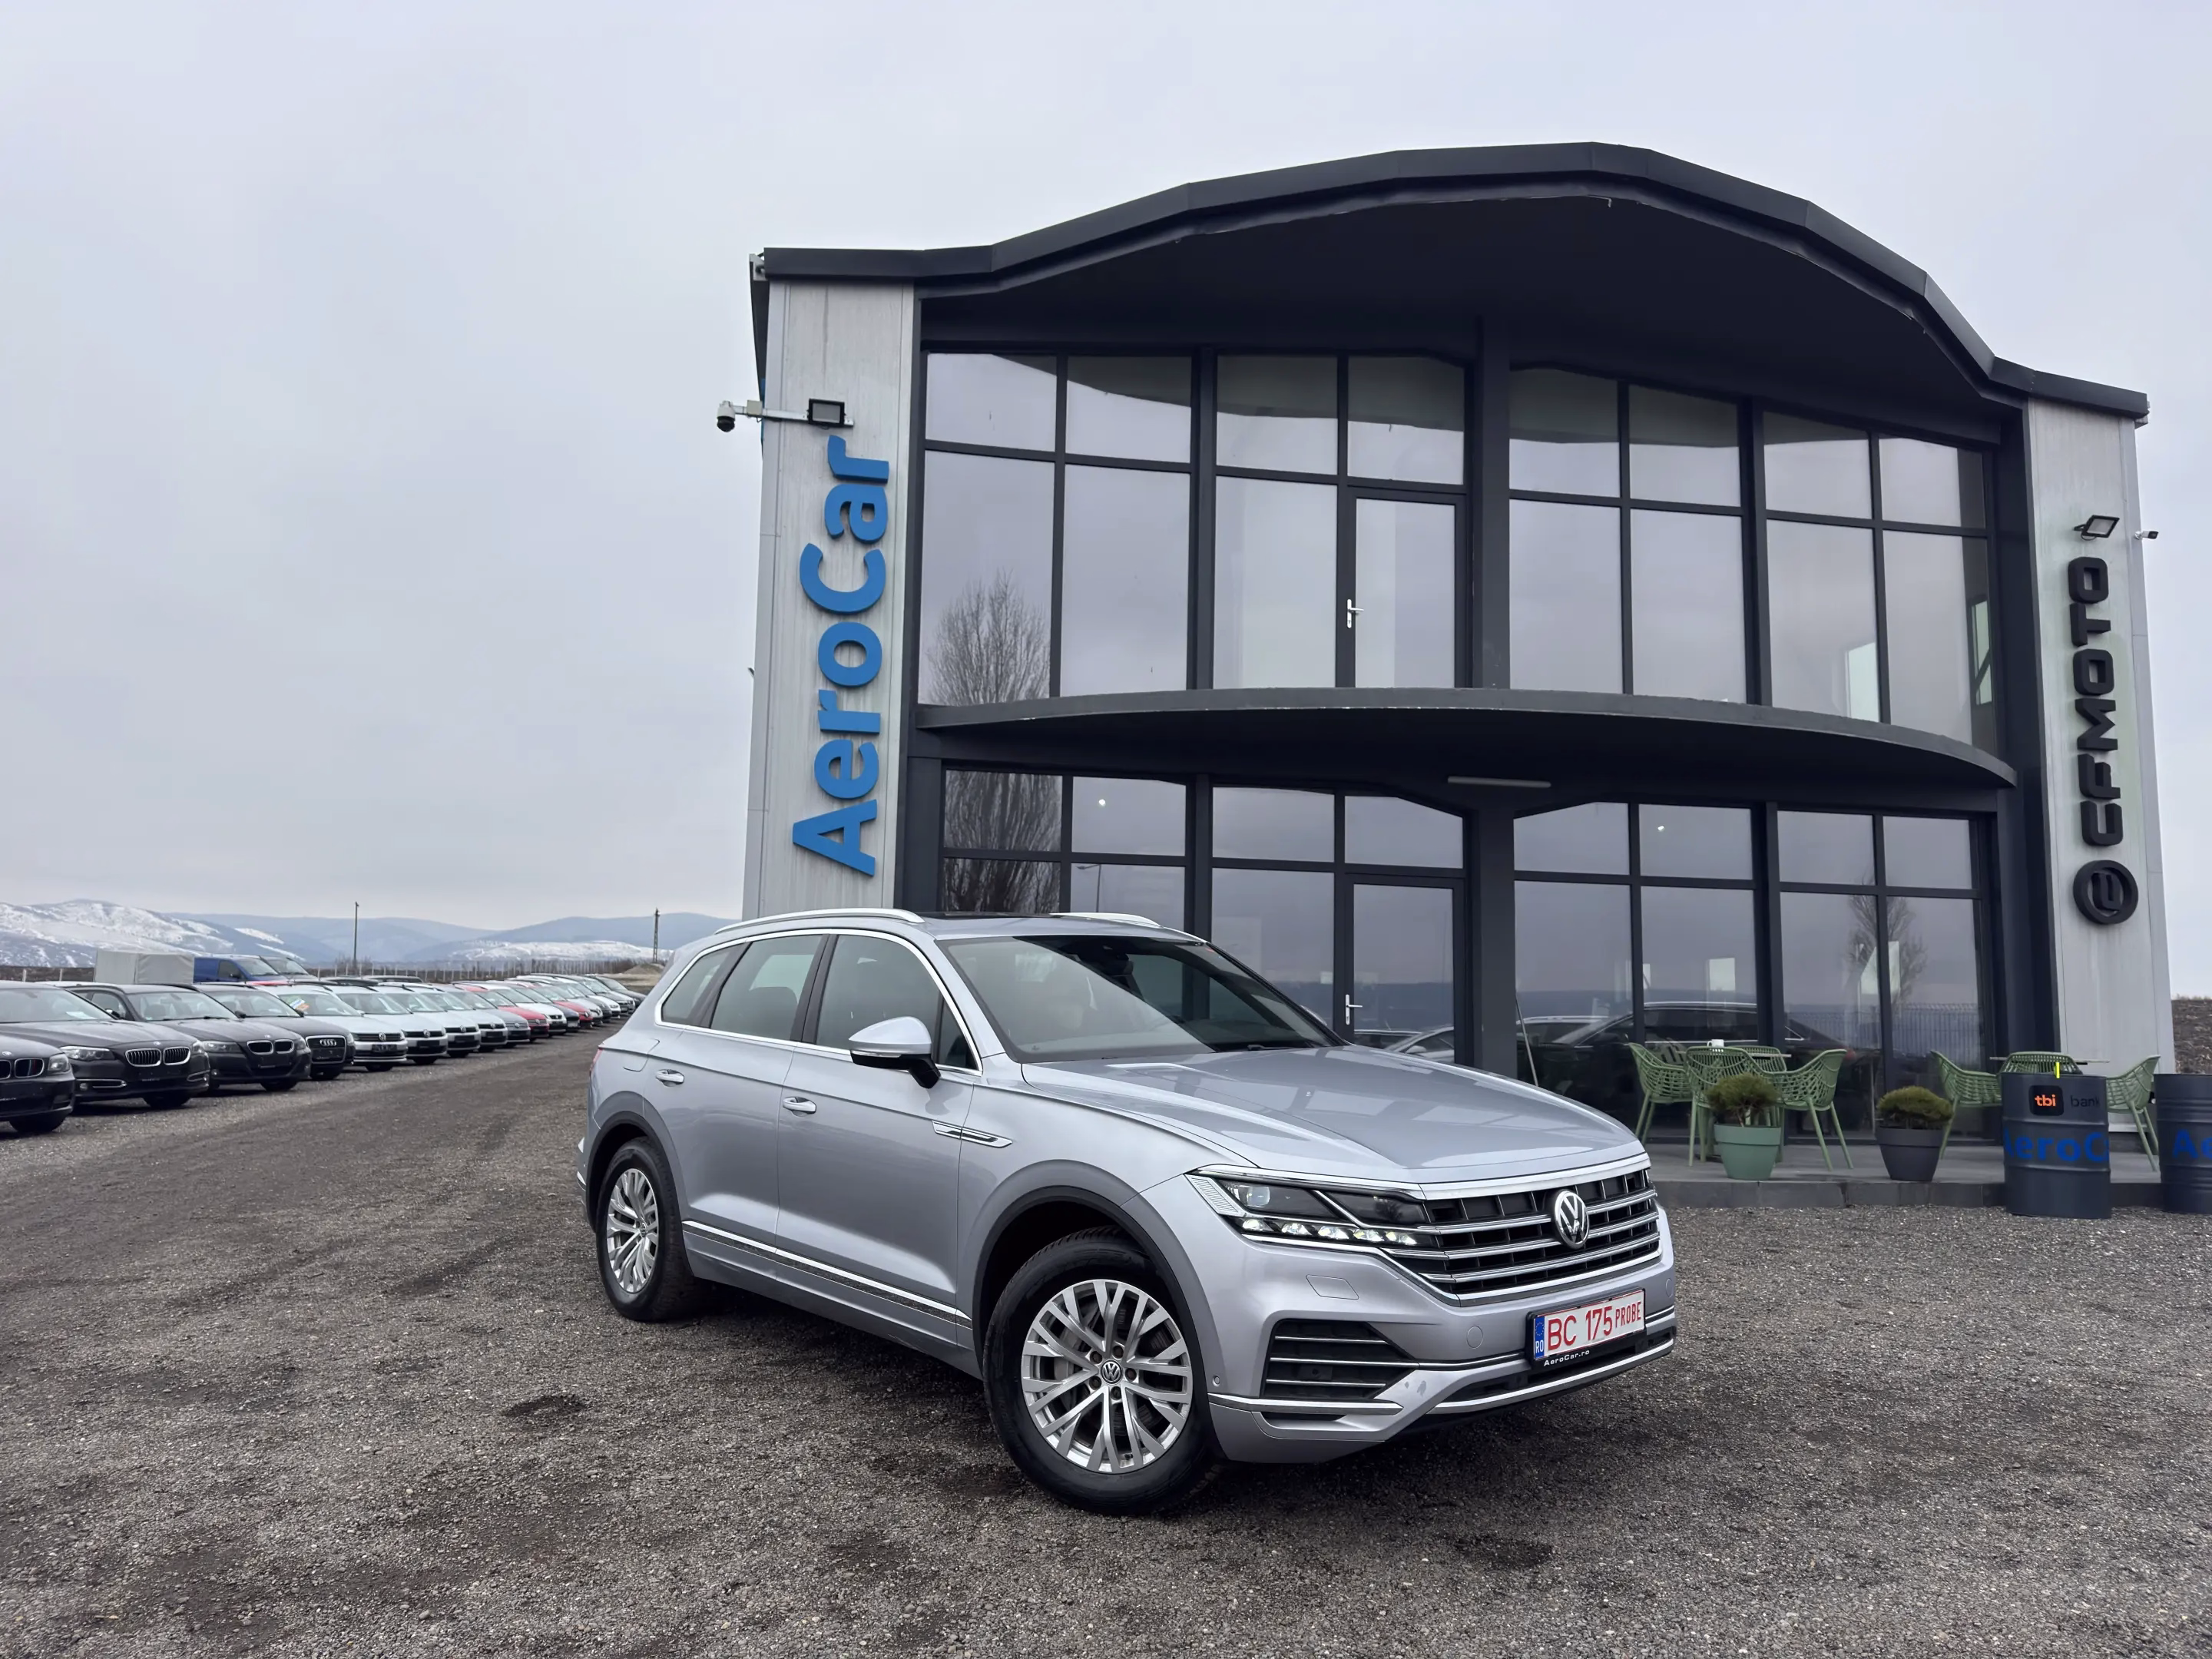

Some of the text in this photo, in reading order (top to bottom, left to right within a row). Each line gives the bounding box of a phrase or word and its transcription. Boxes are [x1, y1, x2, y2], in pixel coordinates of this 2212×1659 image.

[793, 435, 889, 876] AeroCar
[2068, 556, 2123, 846] CFMOTO
[2035, 1094, 2100, 1108] tbi bank
[2004, 1126, 2109, 1162] eroC
[1548, 1301, 1641, 1350] BC 175 PROBE
[1535, 1339, 1544, 1353] RO
[1544, 1350, 1589, 1366] AeroCar.ro
